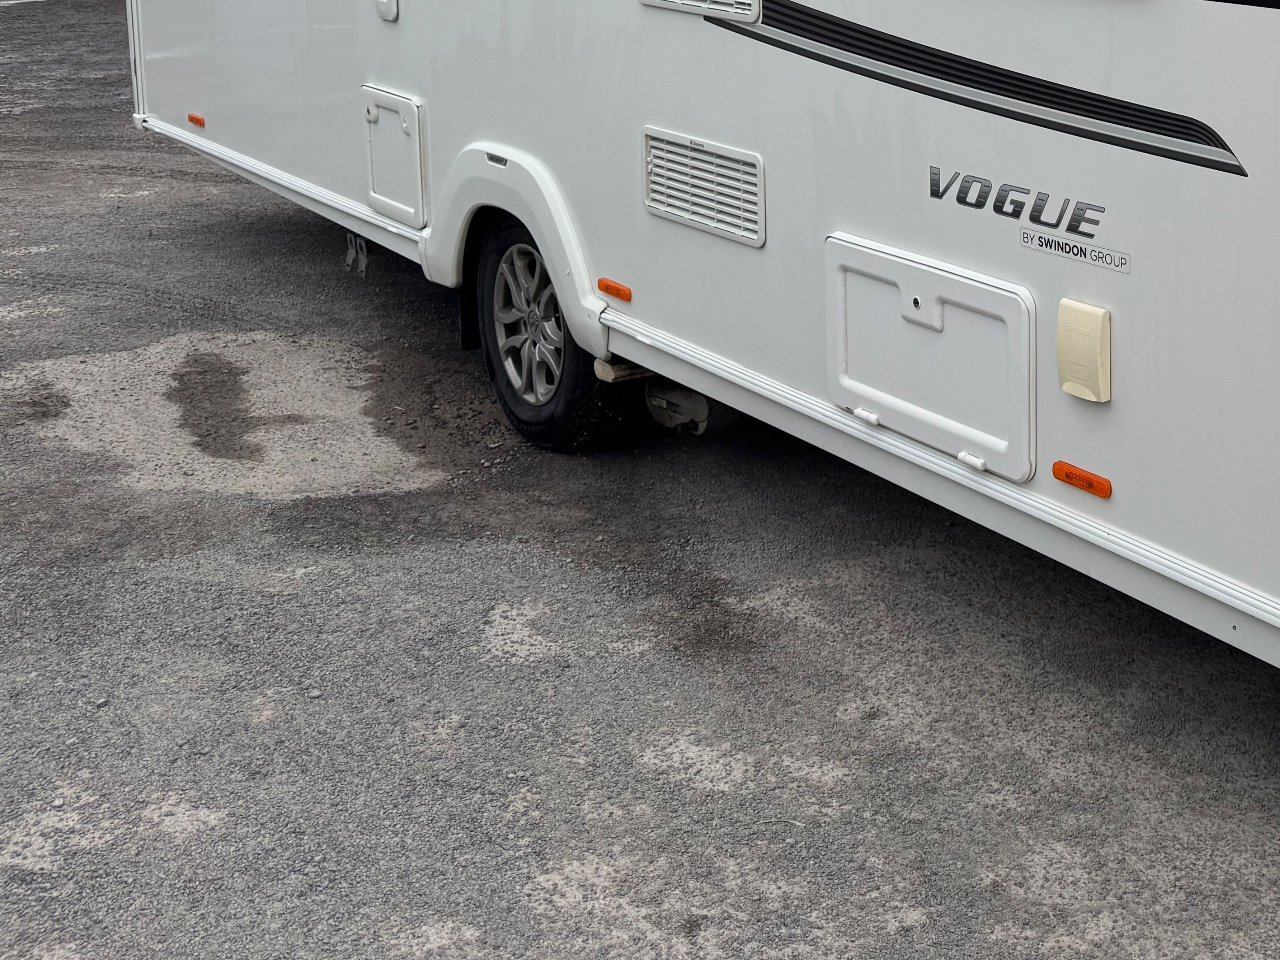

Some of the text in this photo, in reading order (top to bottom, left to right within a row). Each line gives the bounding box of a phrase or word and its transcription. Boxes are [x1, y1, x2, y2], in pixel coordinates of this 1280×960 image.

[929, 165, 1106, 240] VOGUE
[1022, 231, 1128, 269] BY SWINDON GROUP
